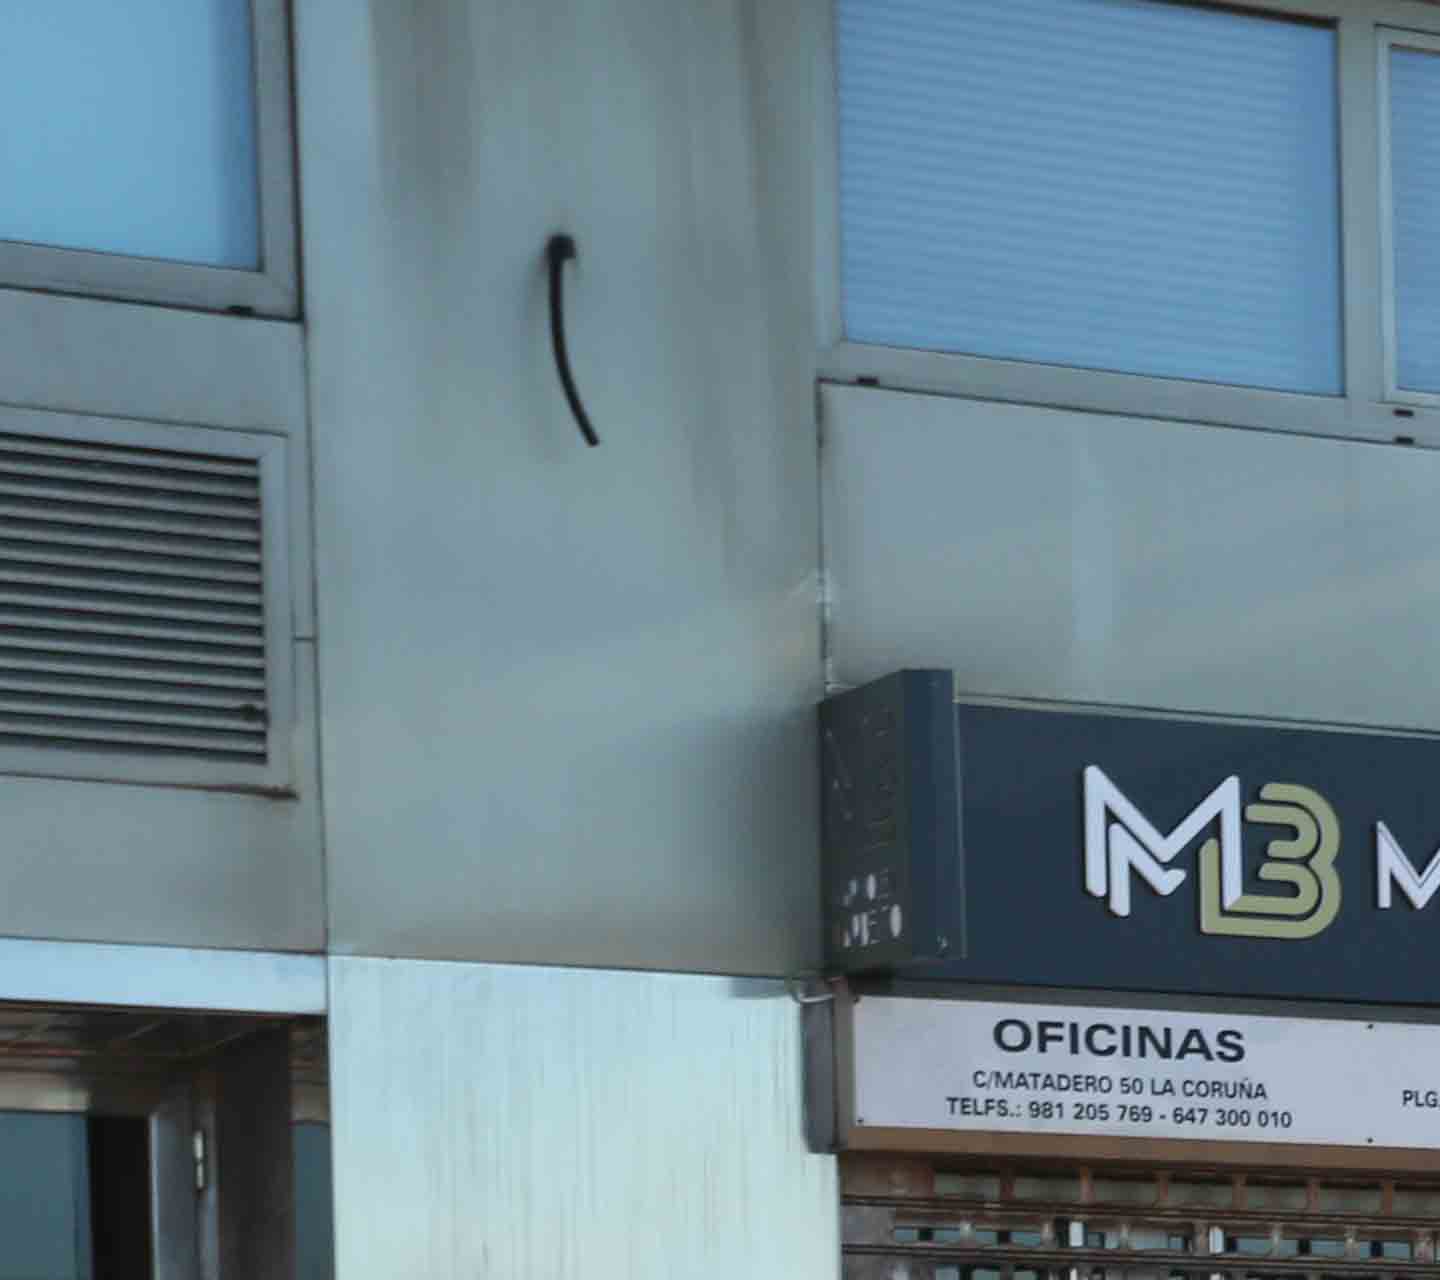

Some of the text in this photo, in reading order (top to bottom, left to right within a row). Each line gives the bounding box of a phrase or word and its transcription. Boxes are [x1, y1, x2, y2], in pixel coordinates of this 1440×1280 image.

[993, 1018, 1245, 1062] OFICINAS
[972, 1070, 1266, 1100] C/MATADERO 50 LA CORUÑA
[946, 1096, 1021, 1119] TELFS.:
[1028, 1101, 1064, 1119] 981
[1074, 1102, 1109, 1121] 205
[1119, 1104, 1152, 1123] 769
[1173, 1106, 1207, 1125] 647
[1216, 1108, 1251, 1126] 300
[1258, 1109, 1292, 1128] 010
